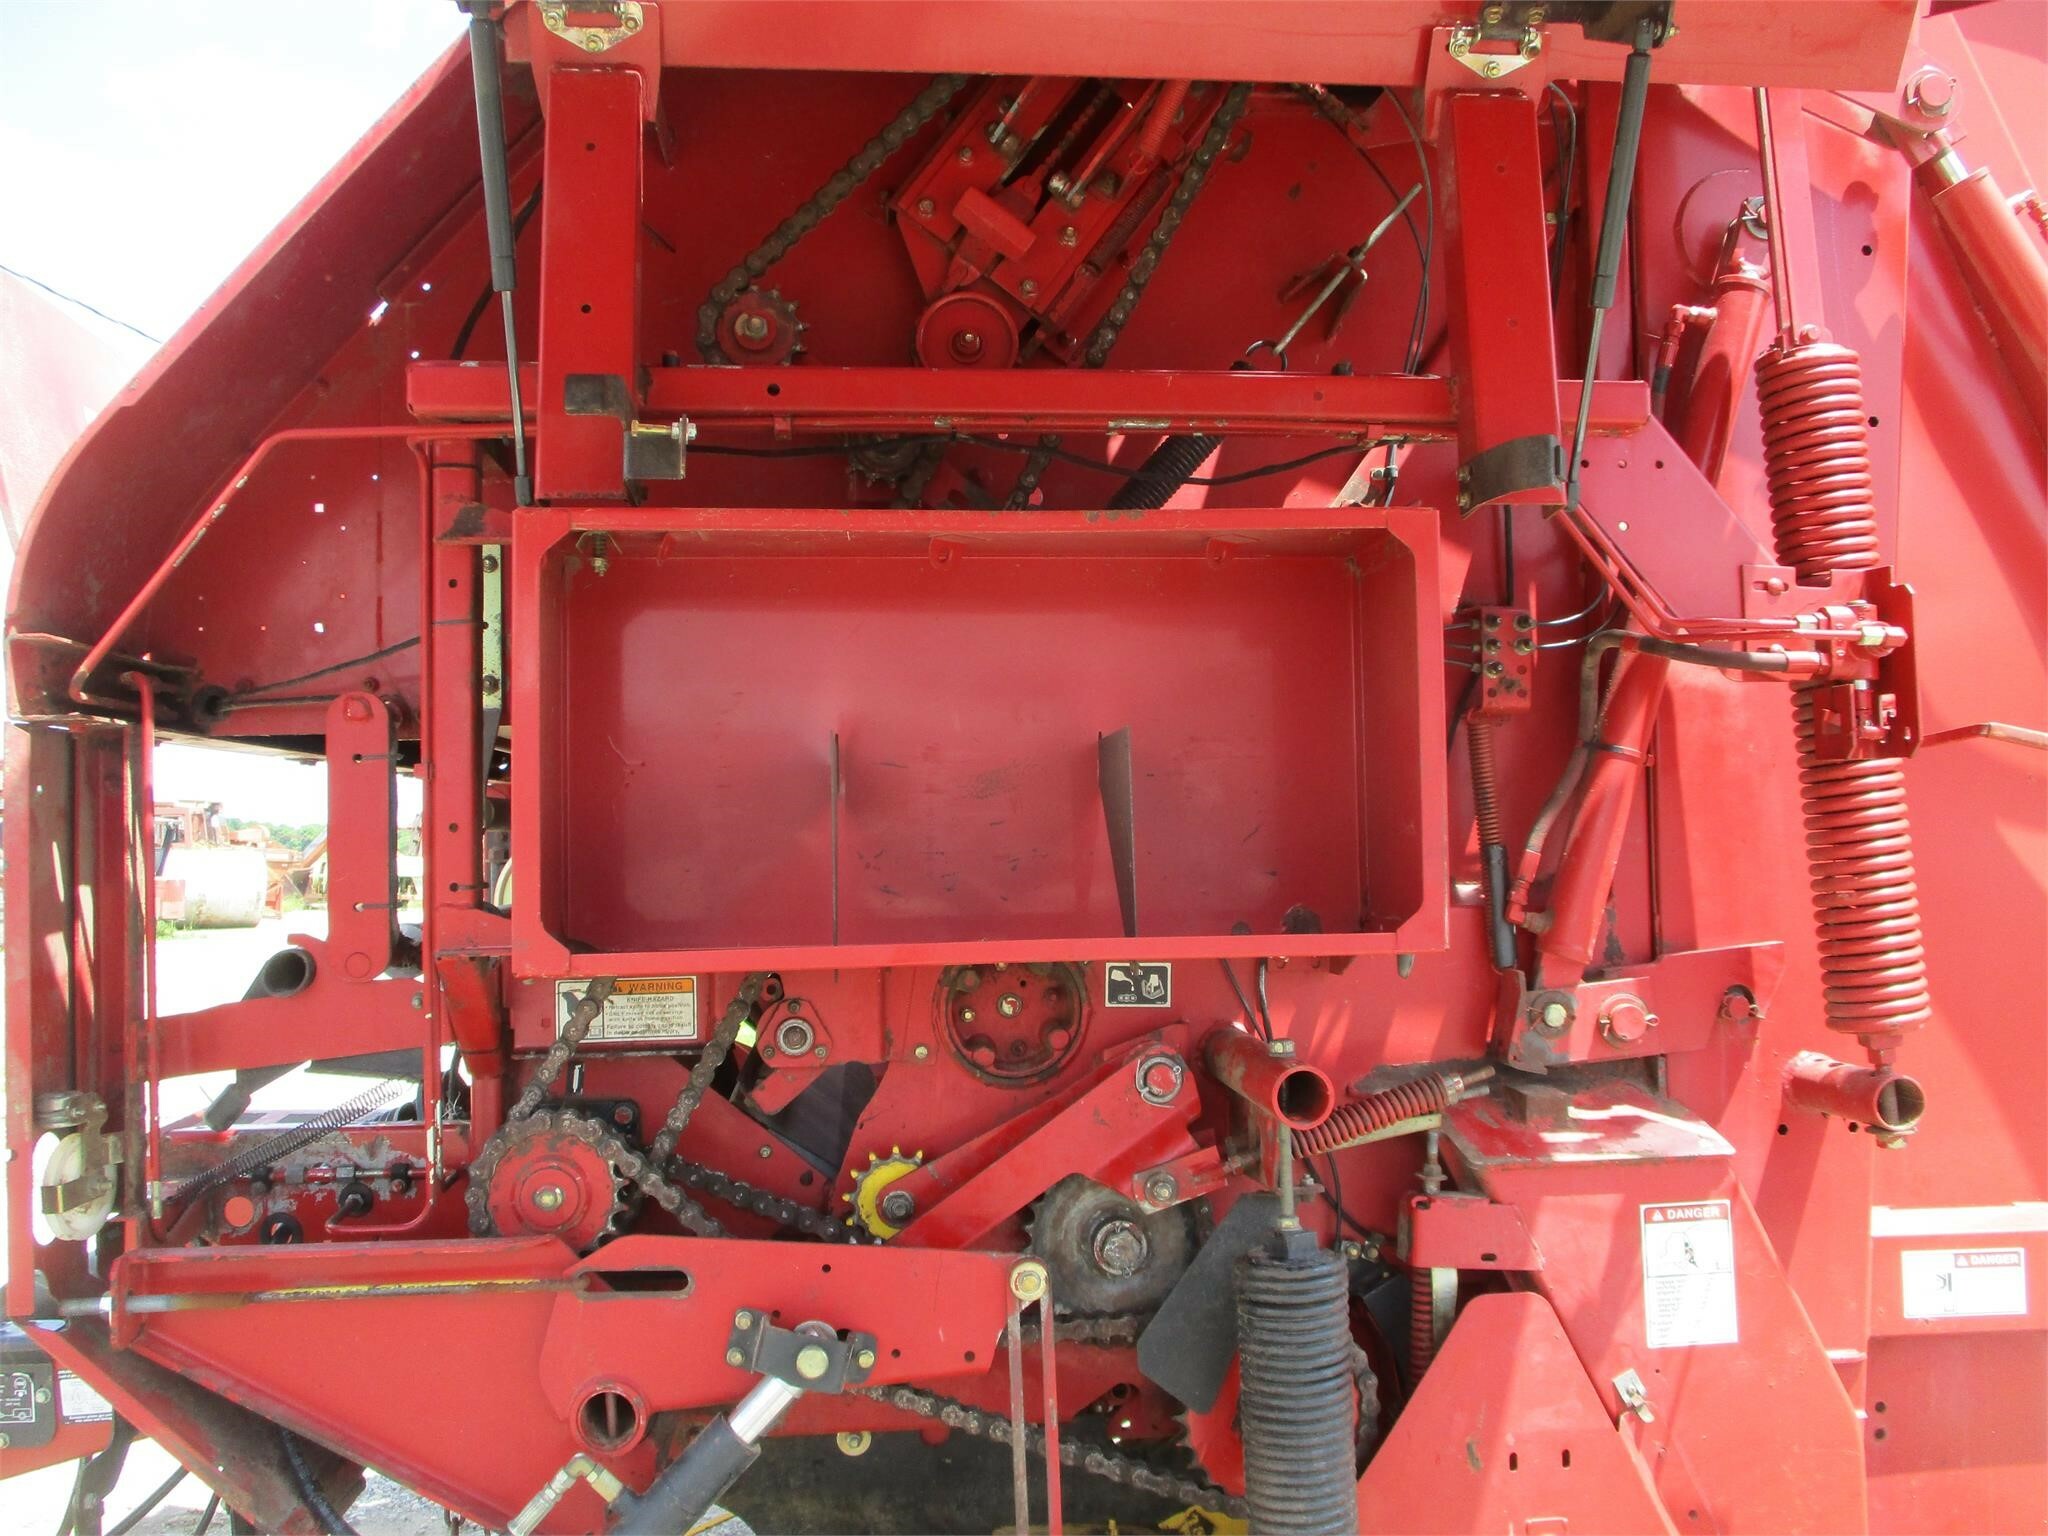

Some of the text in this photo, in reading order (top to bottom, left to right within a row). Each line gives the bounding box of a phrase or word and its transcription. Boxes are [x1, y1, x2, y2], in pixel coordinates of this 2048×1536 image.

[629, 982, 683, 992] WARNING
[1667, 1206, 1720, 1220] DANGER
[1970, 1253, 2019, 1265] DANGER
